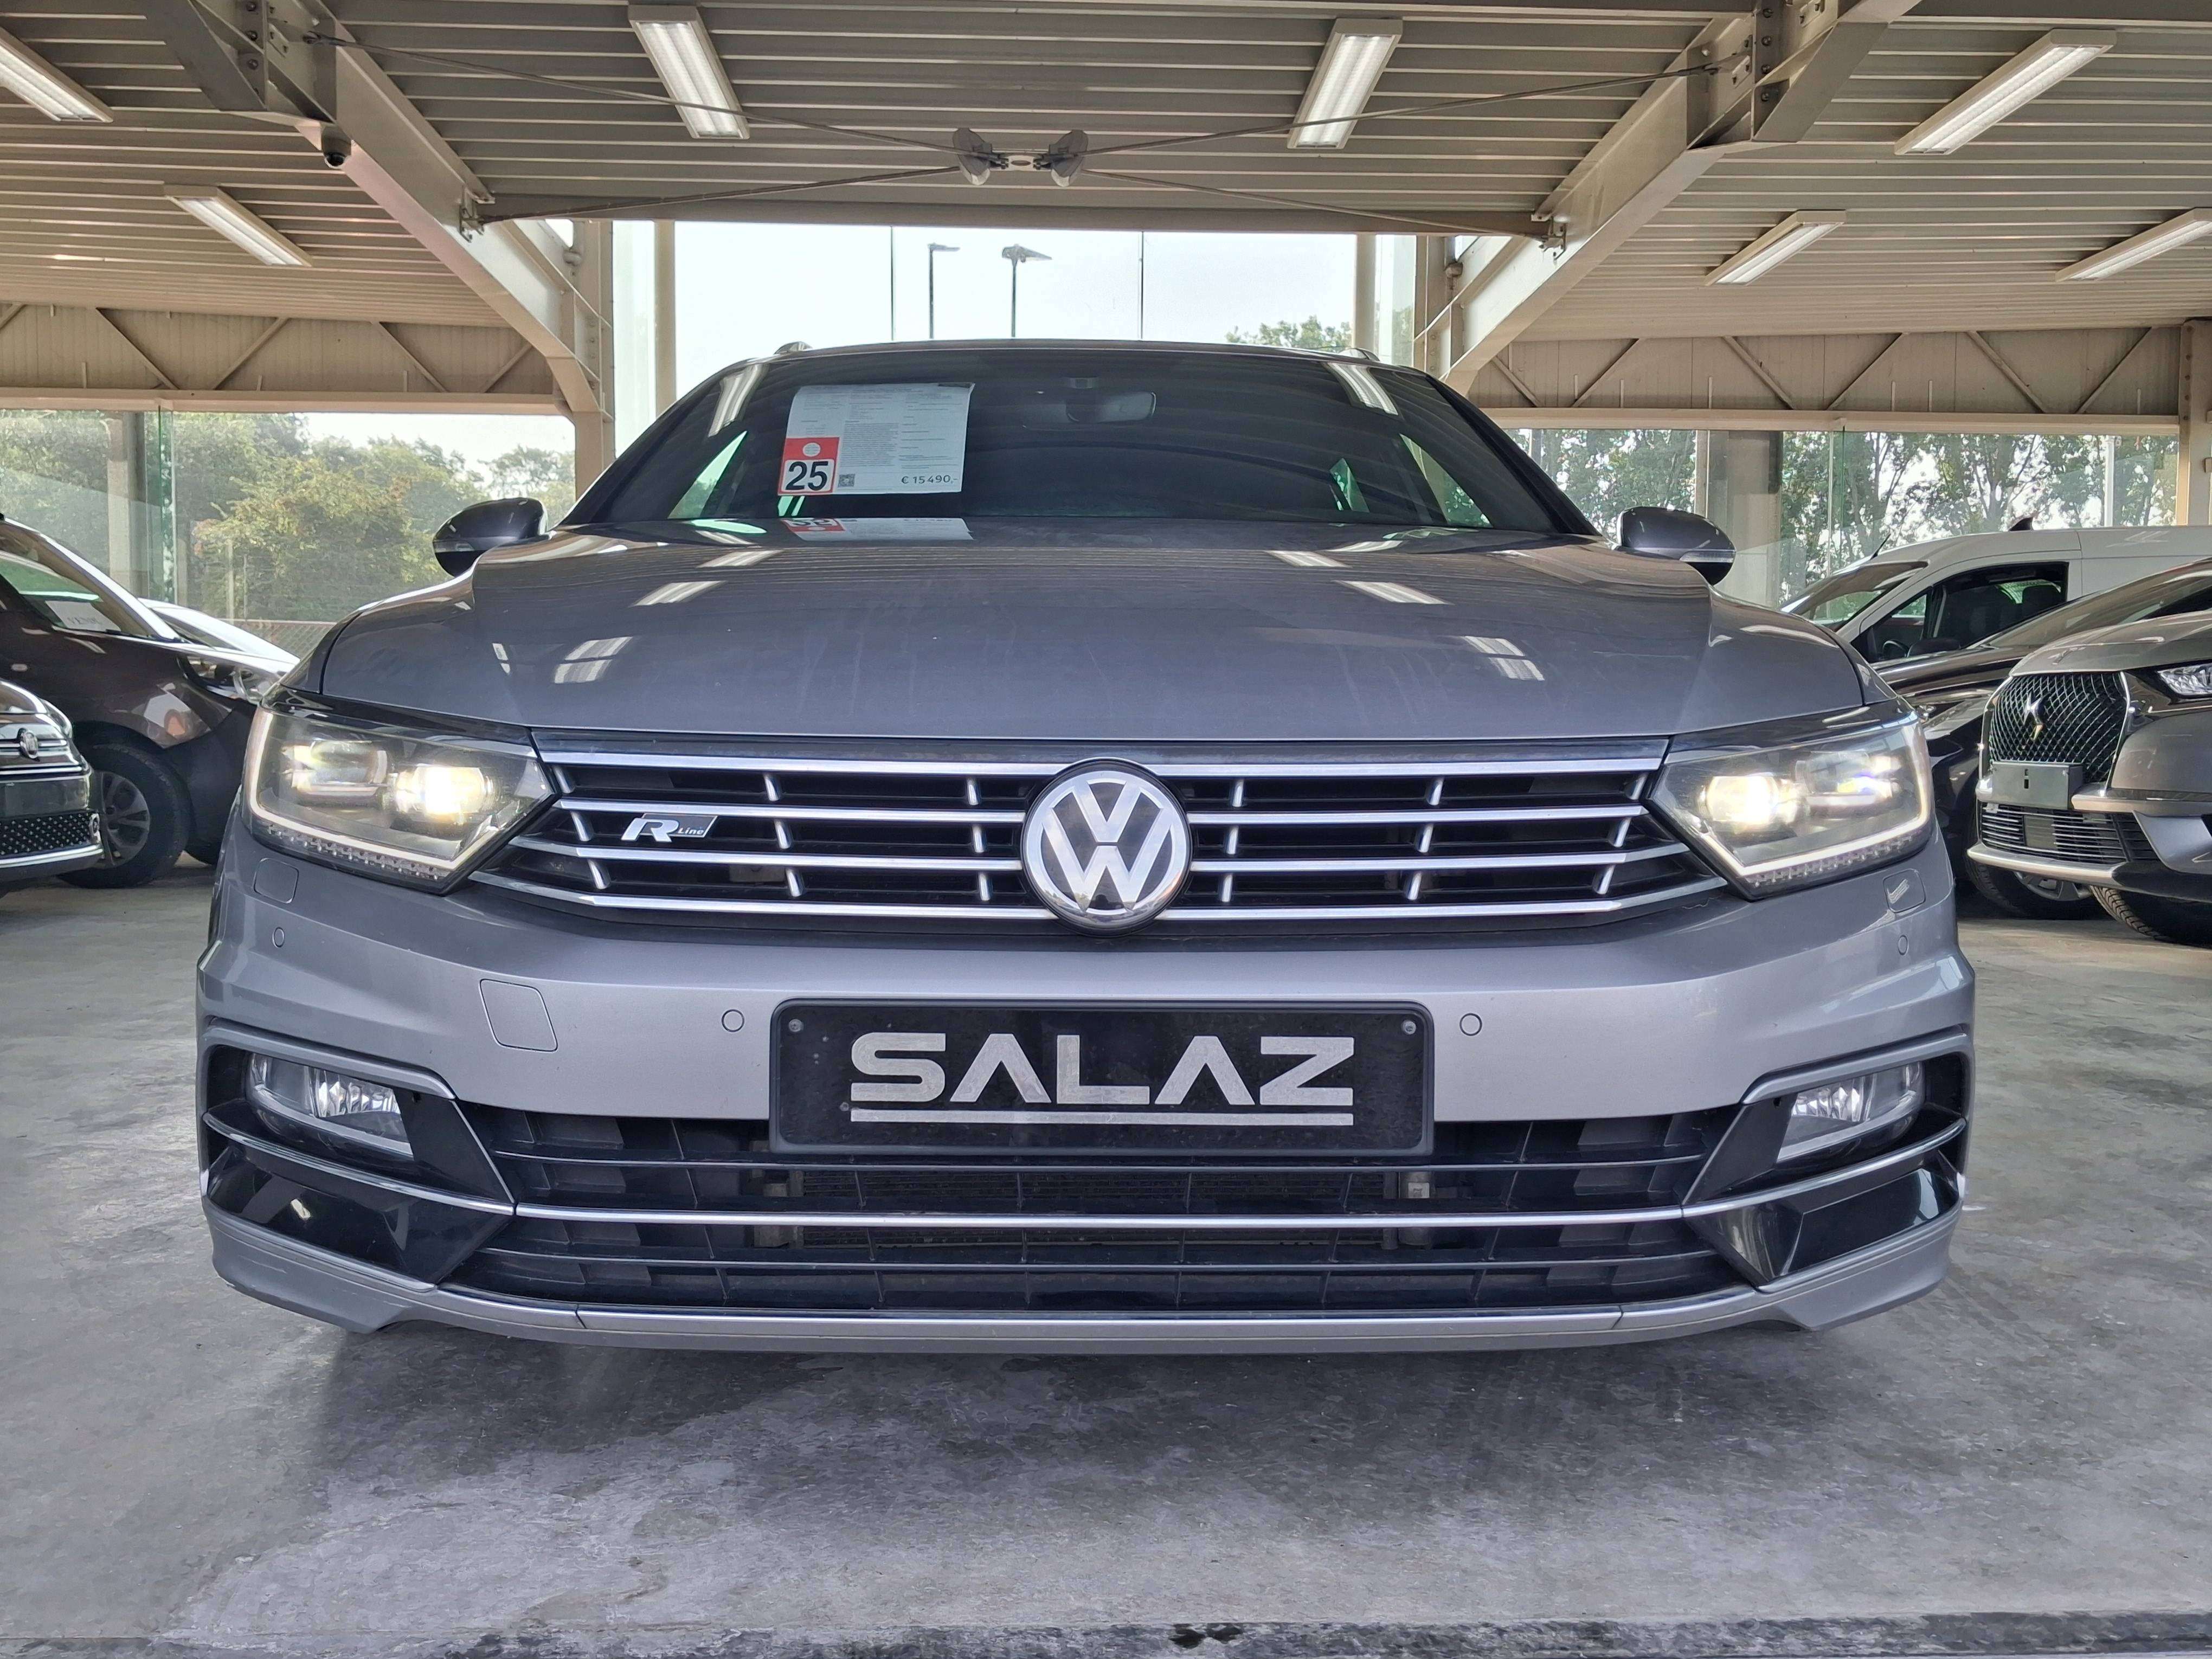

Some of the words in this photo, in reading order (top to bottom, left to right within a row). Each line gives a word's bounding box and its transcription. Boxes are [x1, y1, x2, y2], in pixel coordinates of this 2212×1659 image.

[785, 461, 828, 491] 25
[901, 476, 909, 484] €
[678, 827, 704, 835] Line
[1029, 771, 1185, 915] VW
[851, 1032, 1354, 1105] SALAZ
